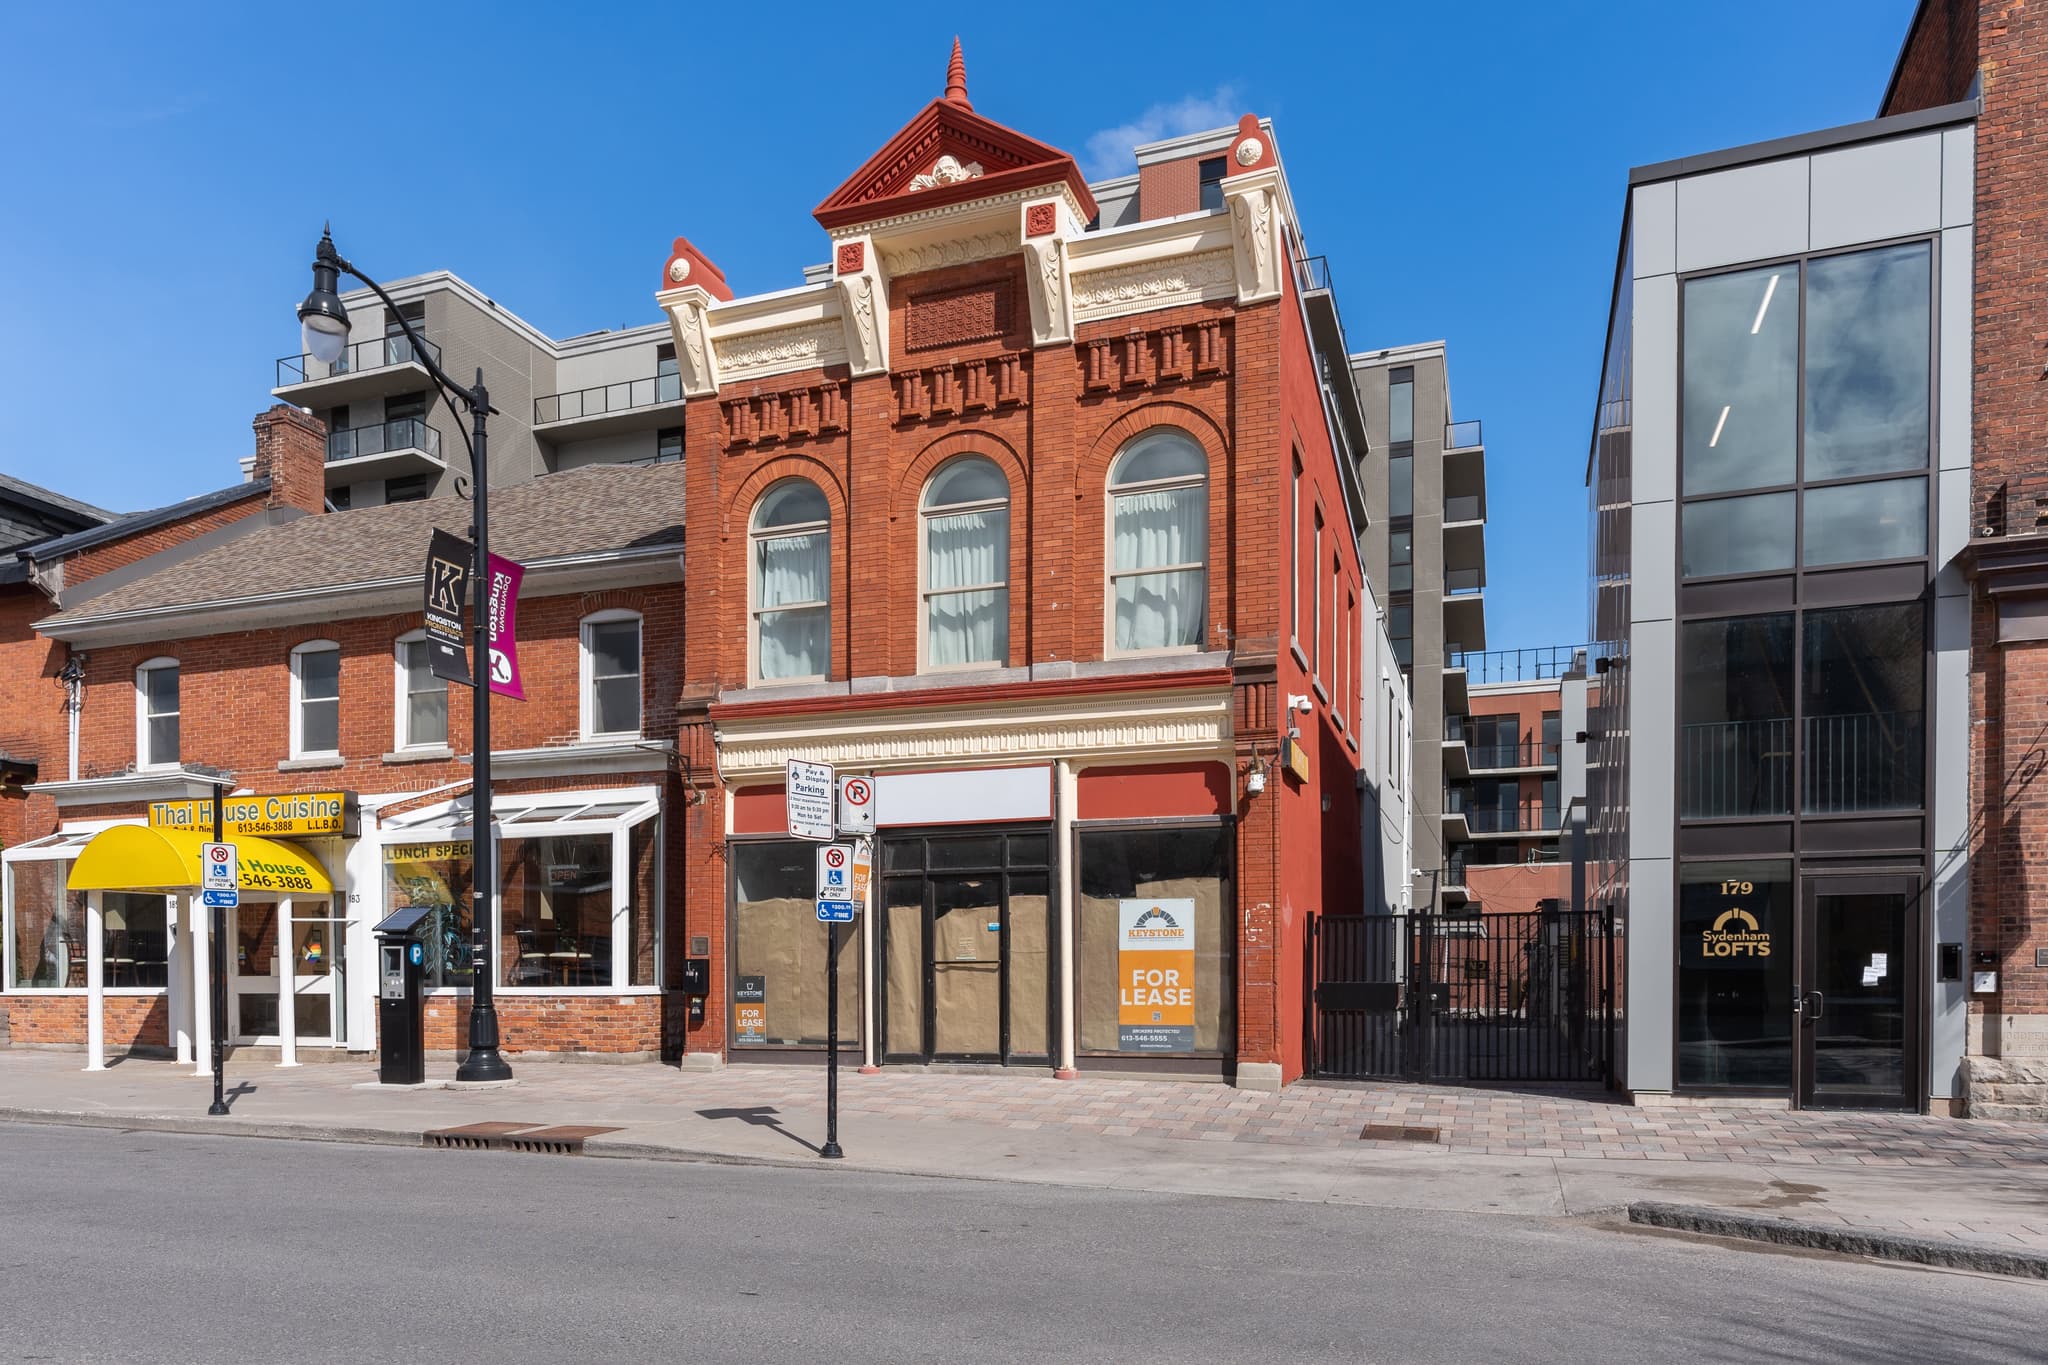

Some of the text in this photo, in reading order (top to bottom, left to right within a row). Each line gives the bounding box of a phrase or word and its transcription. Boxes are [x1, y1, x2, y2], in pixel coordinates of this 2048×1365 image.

[489, 571, 505, 642] Kingston
[499, 575, 512, 633] Downtown
[426, 612, 462, 631] KINGSTON
[805, 775, 829, 785] Display
[795, 783, 825, 796] Parking
[153, 796, 341, 825] Thai Huse Cuisine
[237, 820, 293, 833] 613-546-3888
[307, 819, 341, 831] L.L.B.O.
[386, 844, 473, 860] LUNCH SPECI
[247, 859, 307, 876] House
[238, 873, 313, 890] -546-3888
[551, 870, 577, 881] OPEN
[1720, 881, 1754, 895] 179
[348, 894, 361, 904] 183
[1128, 928, 1185, 937] KEYSTONE
[1702, 930, 1770, 944] Sydenham
[1702, 942, 1771, 957] LOFTS
[1132, 969, 1180, 987] FOR
[1121, 988, 1193, 1006] LEASE
[741, 1009, 760, 1018] FOR
[737, 1018, 764, 1027] LEASE
